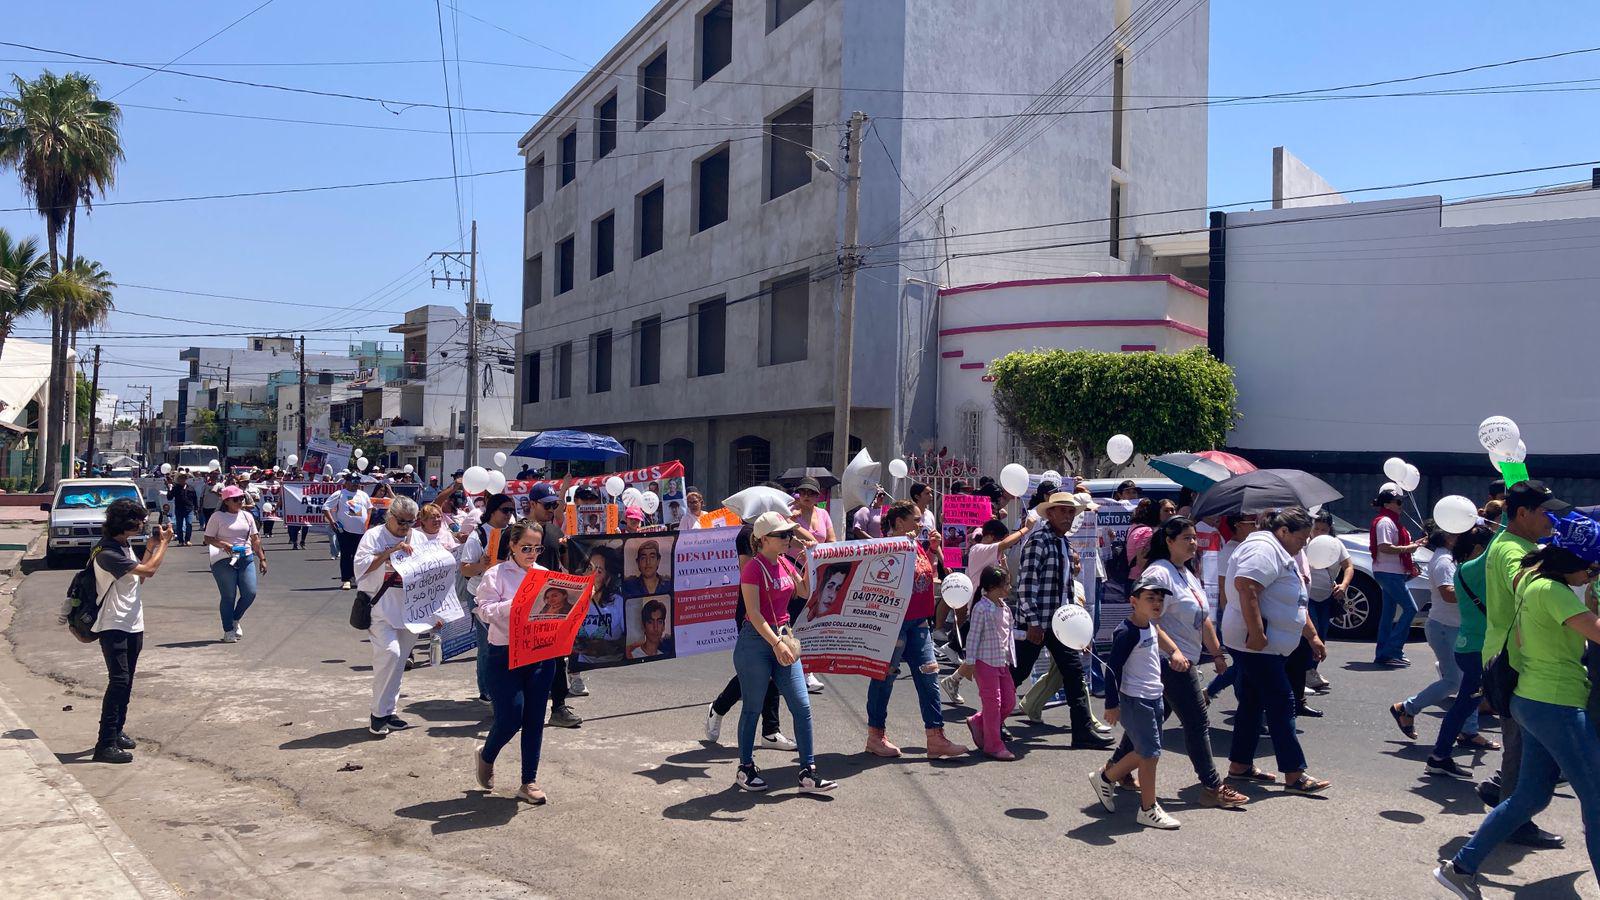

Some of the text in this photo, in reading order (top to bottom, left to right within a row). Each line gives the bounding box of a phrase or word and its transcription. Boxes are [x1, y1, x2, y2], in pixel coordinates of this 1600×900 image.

[299, 515, 328, 523] FAMILI
[1098, 514, 1131, 524] VISTO A?
[813, 546, 854, 560] AYUDANOS
[852, 591, 900, 607] 04/07/2015
[852, 608, 890, 619] ROSARIO, SIN
[858, 622, 882, 632] ARAGÓN
